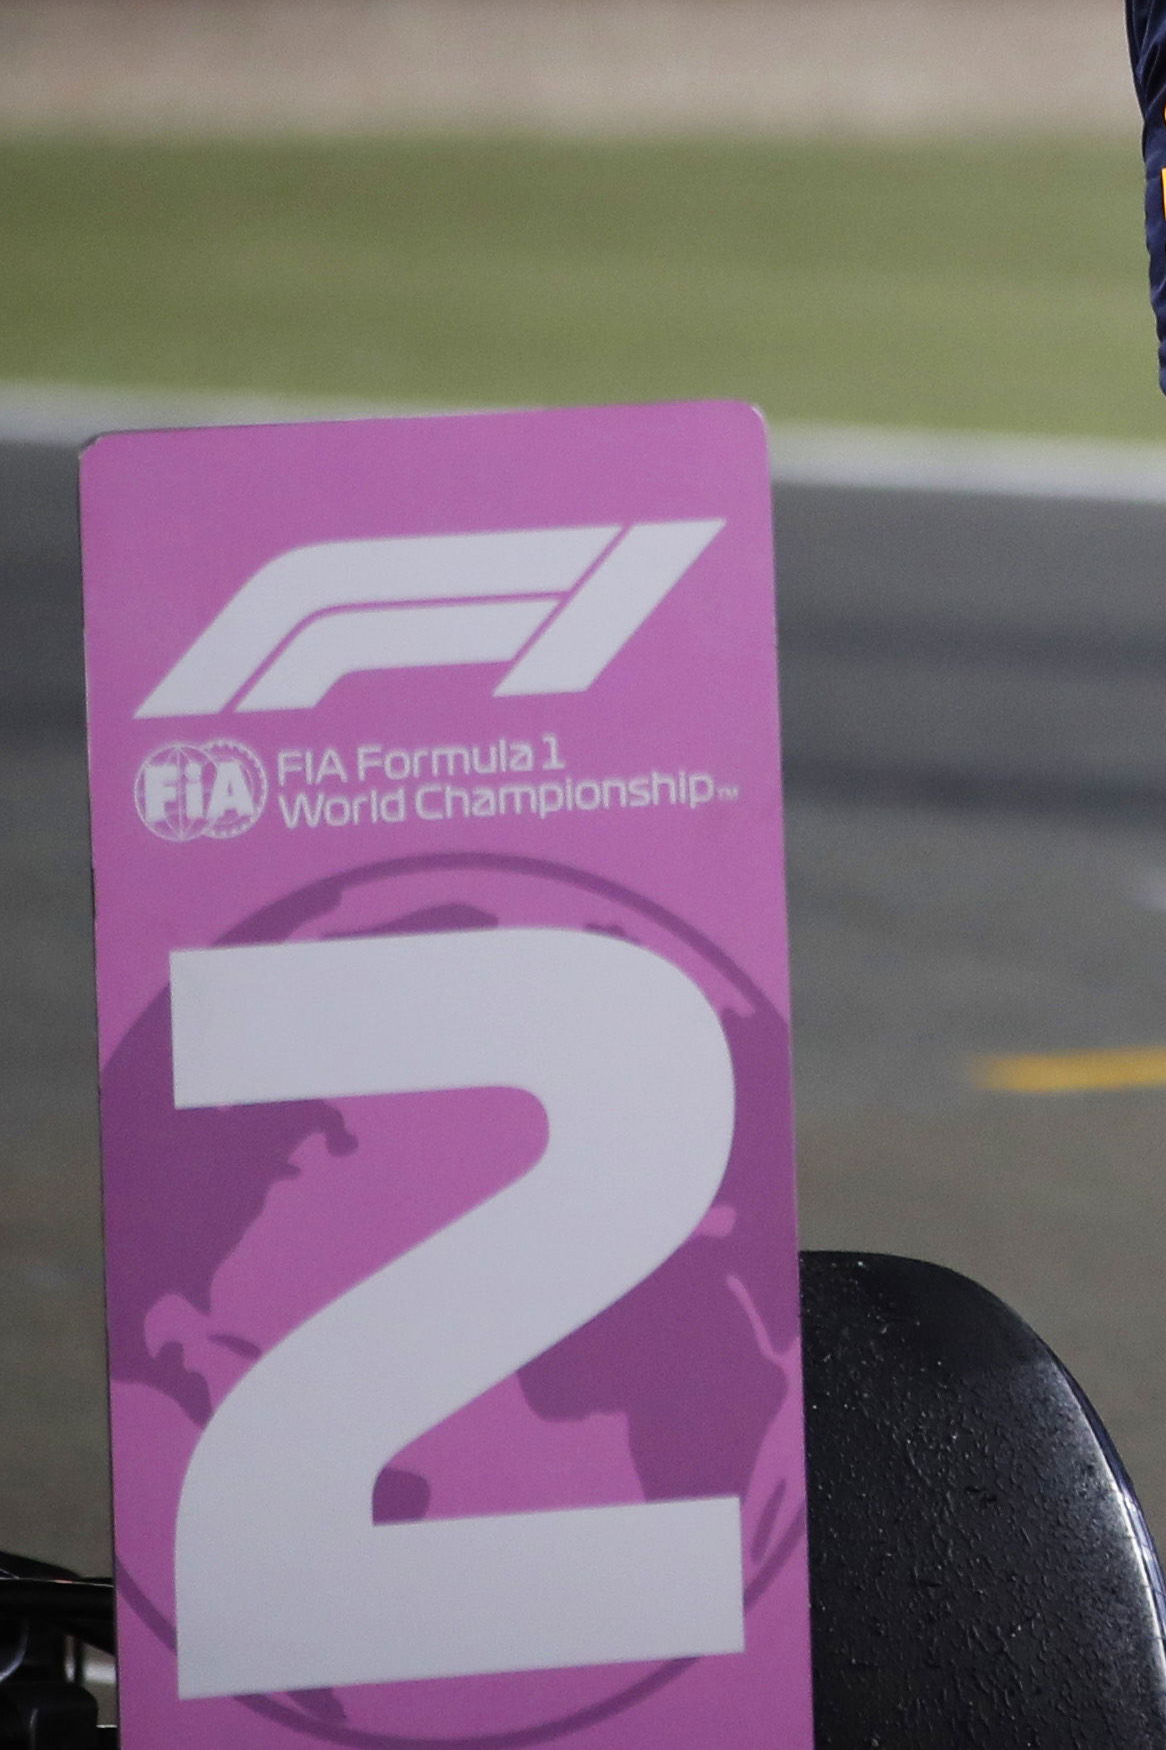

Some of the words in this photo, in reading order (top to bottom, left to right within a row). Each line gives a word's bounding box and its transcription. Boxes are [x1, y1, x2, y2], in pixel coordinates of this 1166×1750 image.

[132, 518, 727, 718] F1
[277, 748, 349, 786] FIA
[357, 739, 535, 780] Formula
[542, 734, 566, 769] 1
[278, 786, 405, 829] World
[170, 926, 745, 1701] 2
